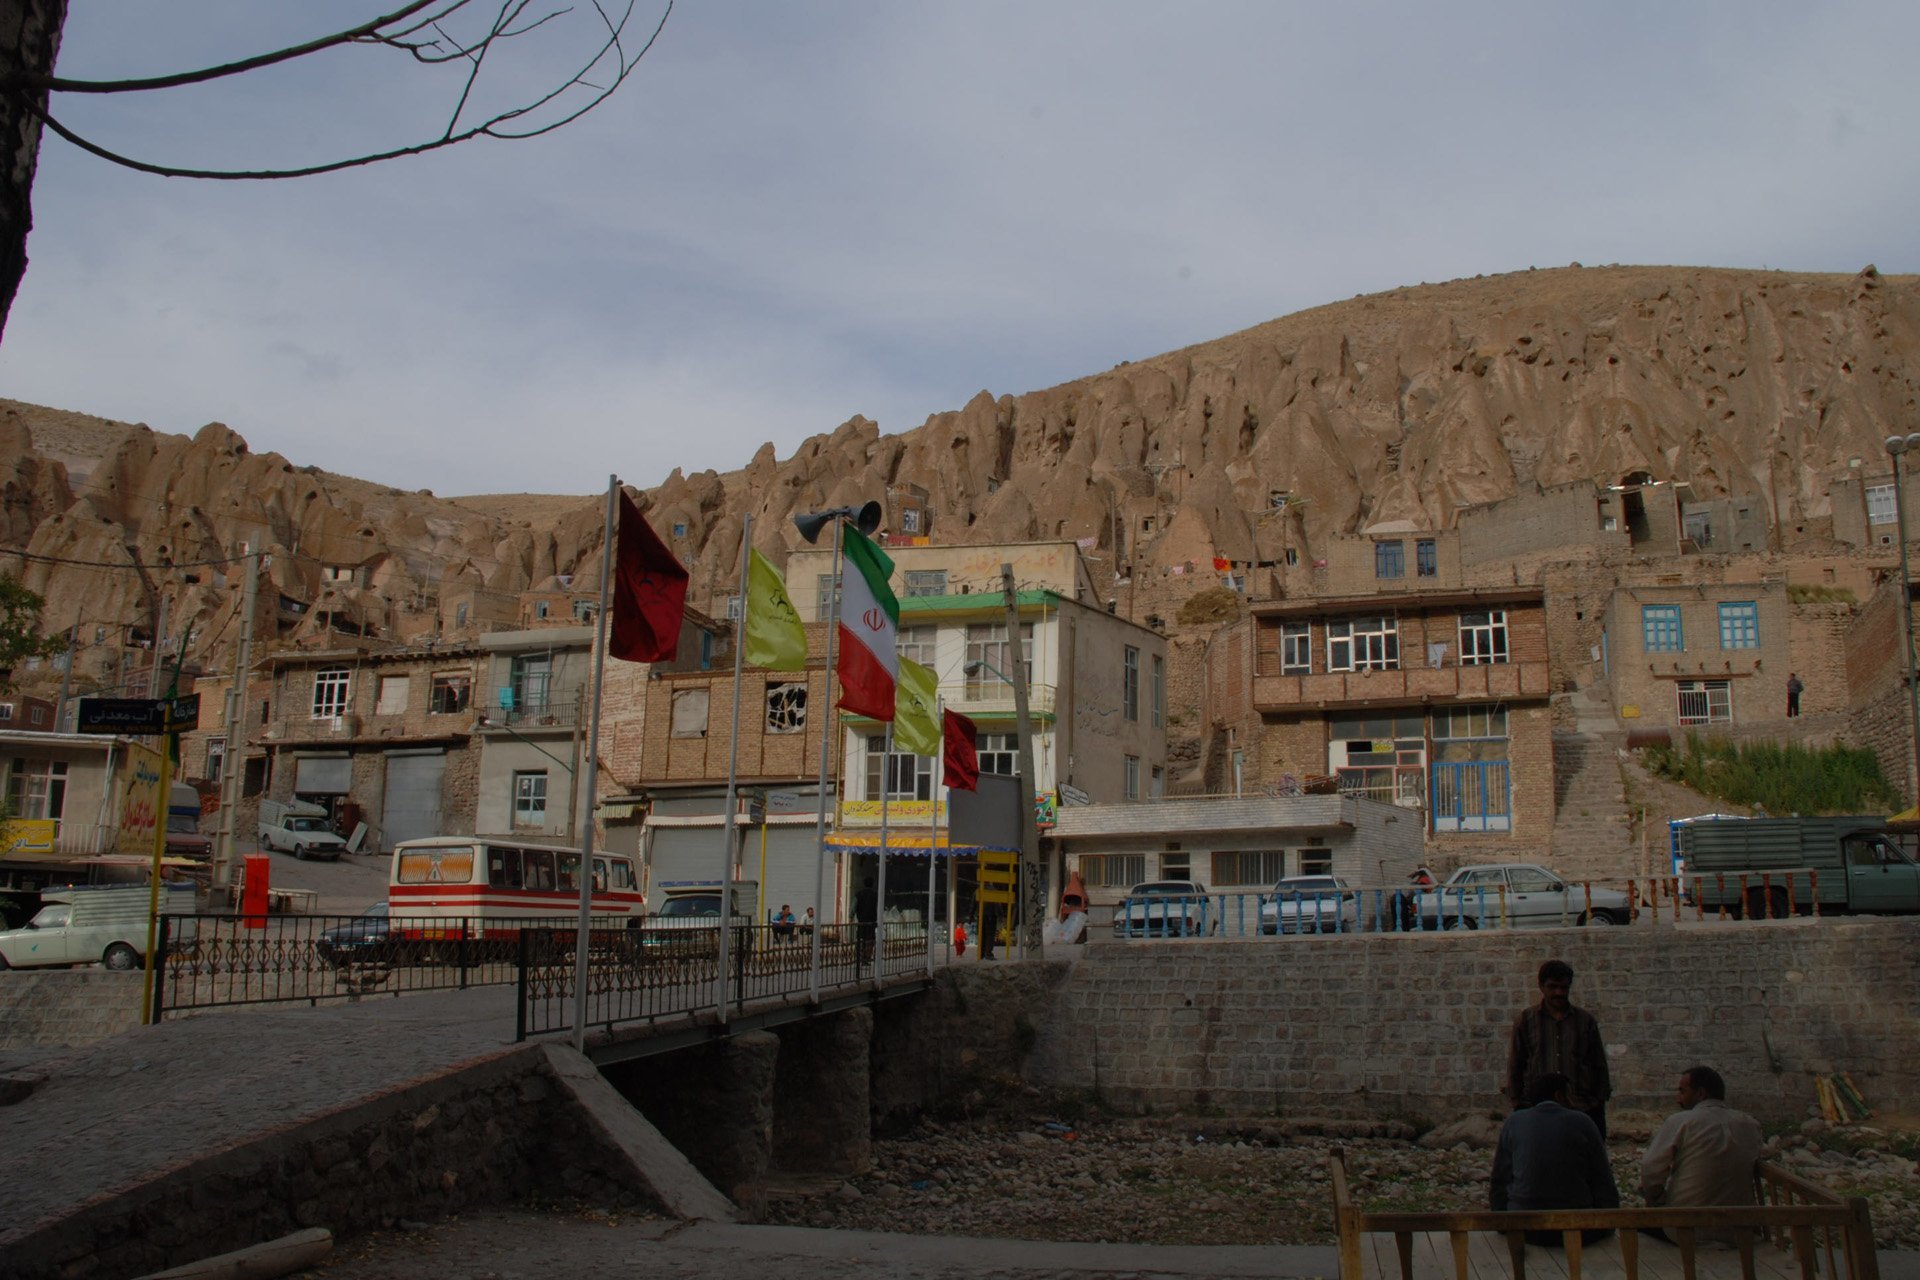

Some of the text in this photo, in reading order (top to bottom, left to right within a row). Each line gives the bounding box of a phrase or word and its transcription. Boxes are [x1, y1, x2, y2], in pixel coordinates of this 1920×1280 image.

[89, 707, 156, 724] آب معدنی
[173, 704, 197, 720] نمازخانه
